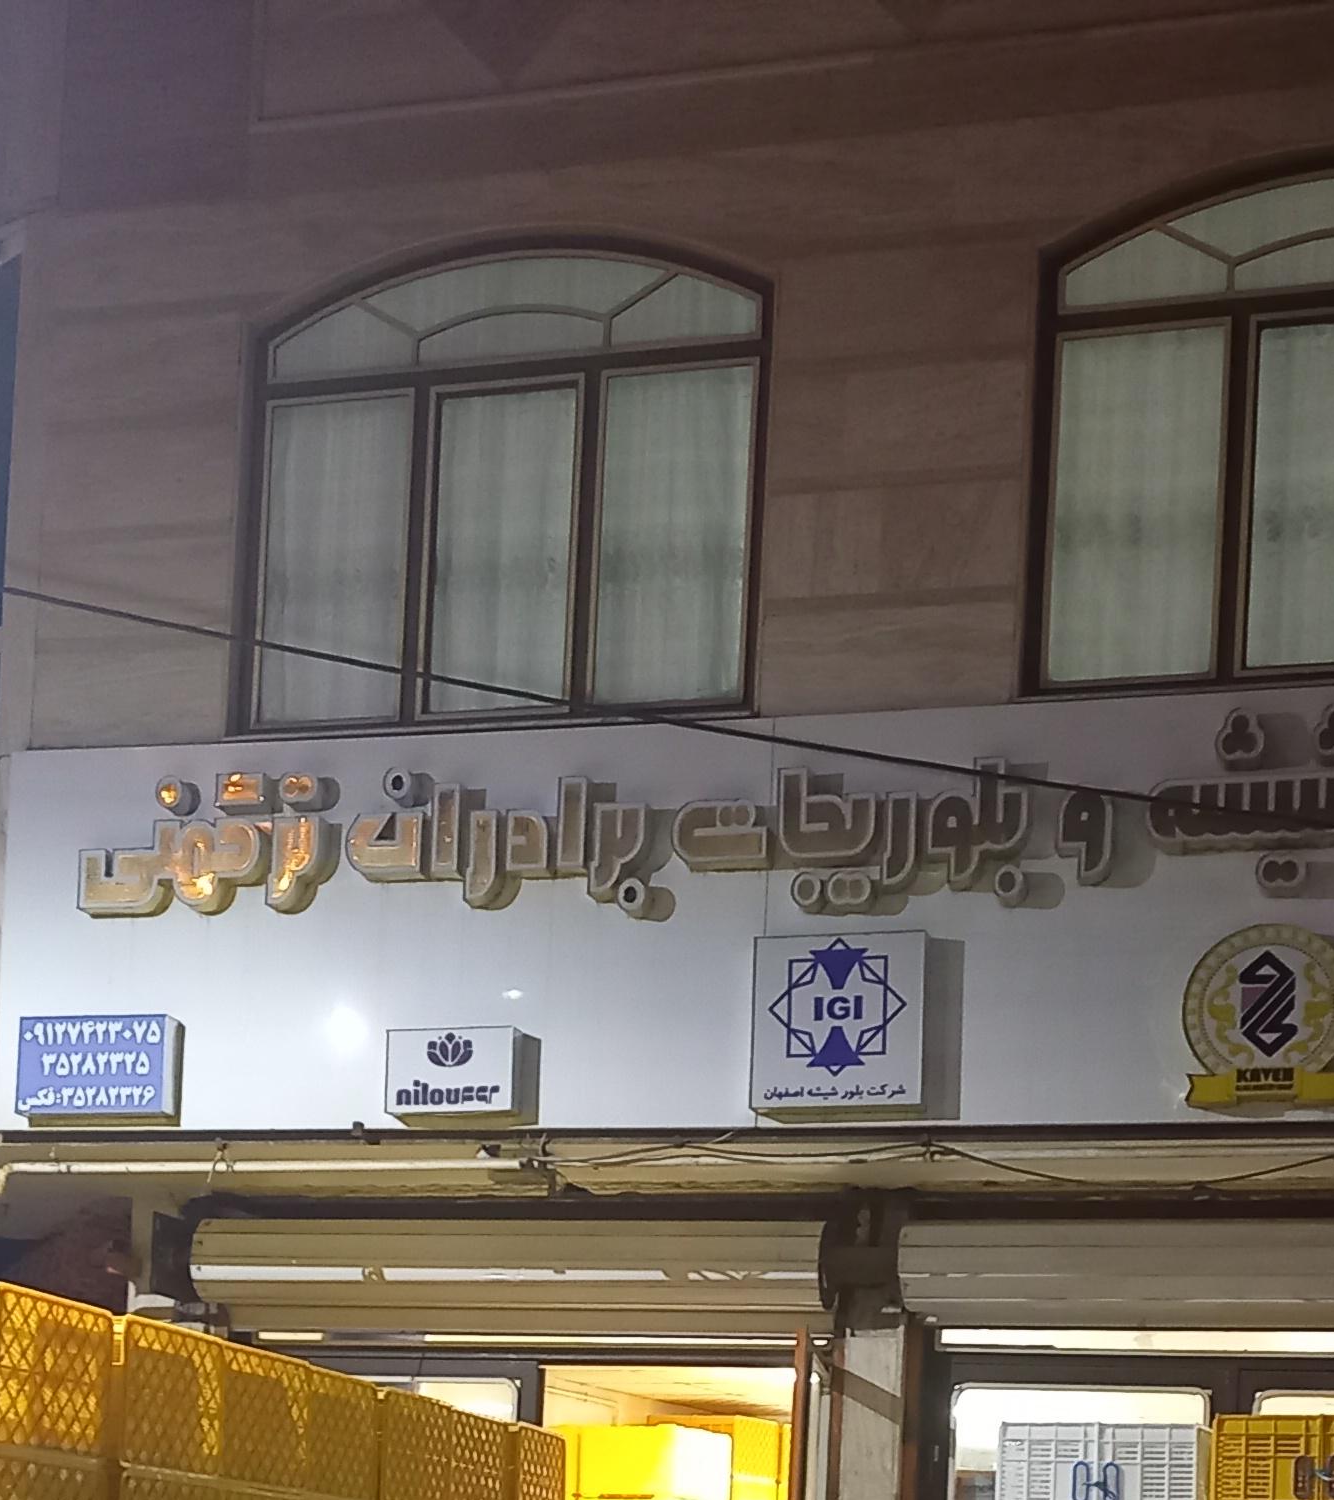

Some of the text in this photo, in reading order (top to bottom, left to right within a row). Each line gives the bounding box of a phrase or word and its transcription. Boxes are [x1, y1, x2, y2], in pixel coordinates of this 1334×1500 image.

[346, 767, 652, 920] برادران
[672, 755, 1033, 914] بلوریجات
[1058, 789, 1113, 887] و
[814, 995, 863, 1021] IGI
[763, 1084, 906, 1100] شرکت بلور شیشه اصفهان
